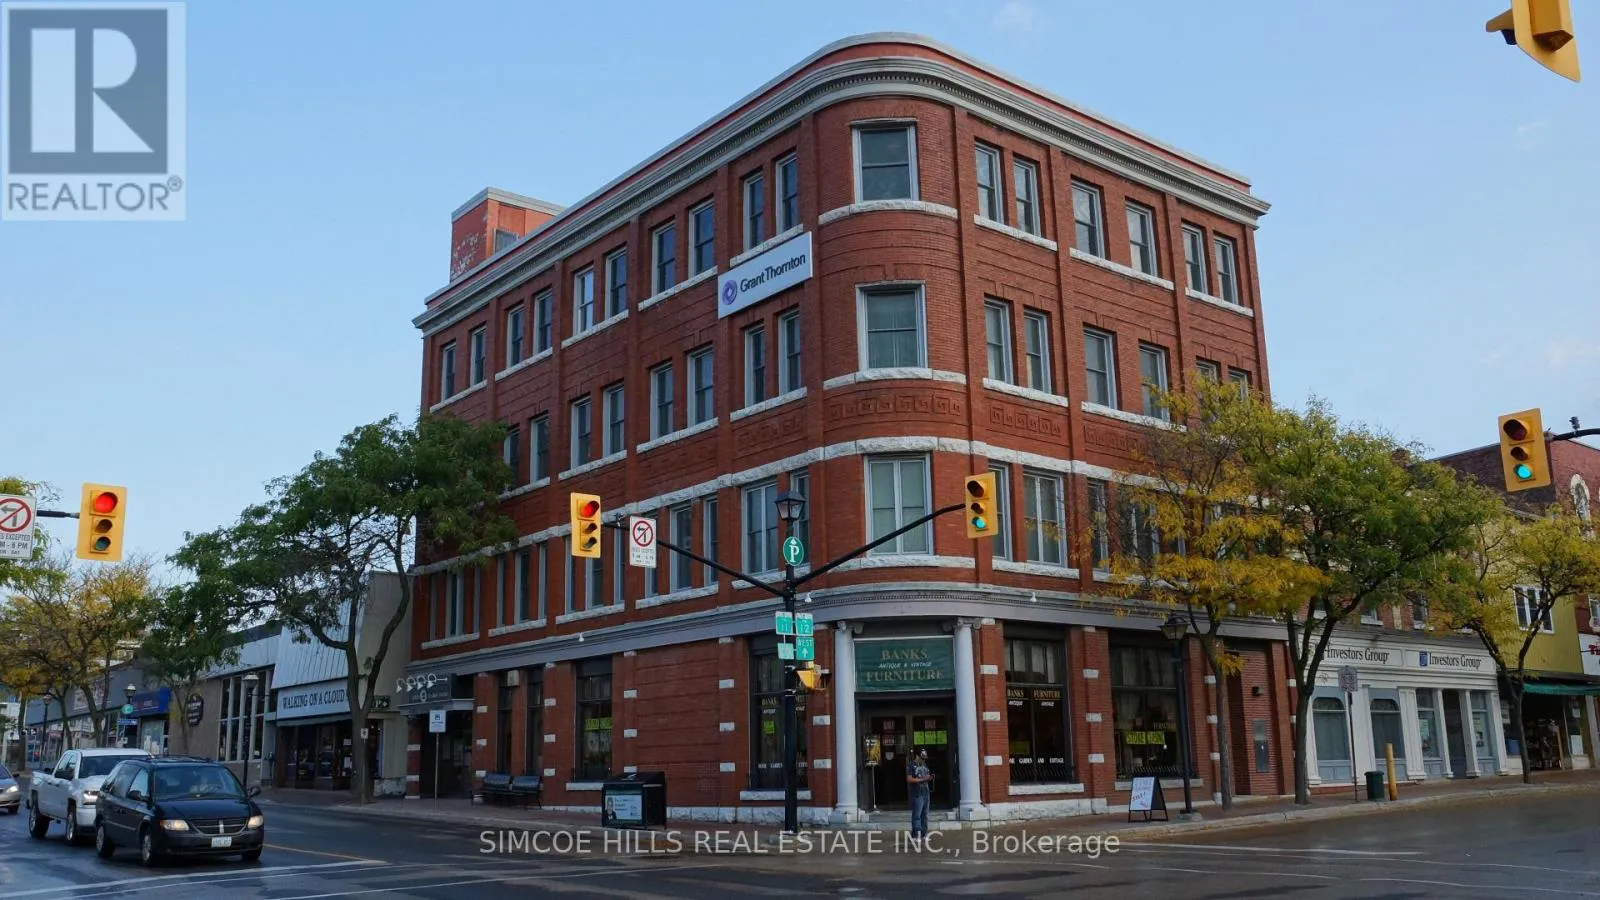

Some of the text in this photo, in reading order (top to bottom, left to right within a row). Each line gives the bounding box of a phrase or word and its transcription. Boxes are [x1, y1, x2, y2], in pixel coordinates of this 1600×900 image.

[740, 254, 806, 292] Grant Thornton
[789, 544, 800, 563] P
[800, 624, 810, 633] 12
[881, 648, 928, 660] BANKS
[1326, 648, 1390, 664] Investors Group
[1429, 652, 1482, 670] Investors Group
[866, 669, 945, 682] FURNITURE
[283, 689, 346, 709] WALKING ON A CLOUD
